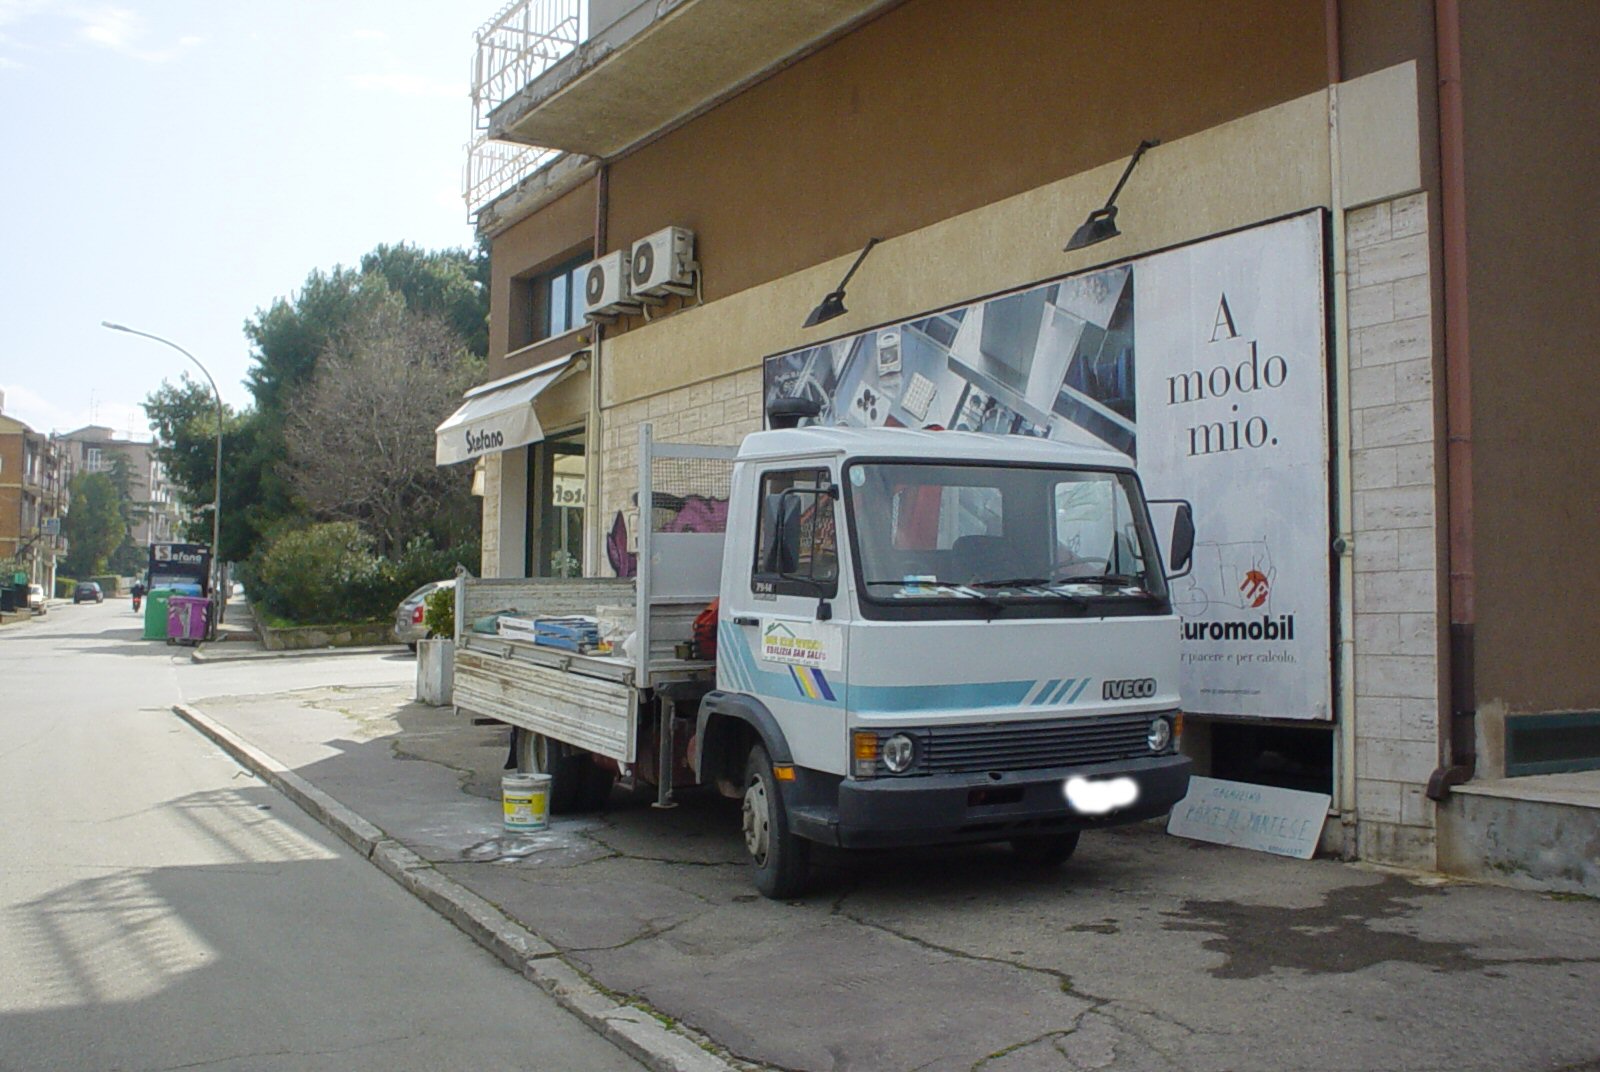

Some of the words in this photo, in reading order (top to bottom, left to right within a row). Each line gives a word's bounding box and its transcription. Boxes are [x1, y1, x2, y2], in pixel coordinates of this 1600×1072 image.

[1208, 292, 1241, 343] A
[1166, 340, 1287, 405] modo
[466, 428, 504, 455] Stefano
[1187, 404, 1278, 456] mio.
[1181, 615, 1294, 640] uromobil
[1236, 653, 1253, 666] per
[1102, 678, 1157, 700] IVECO
